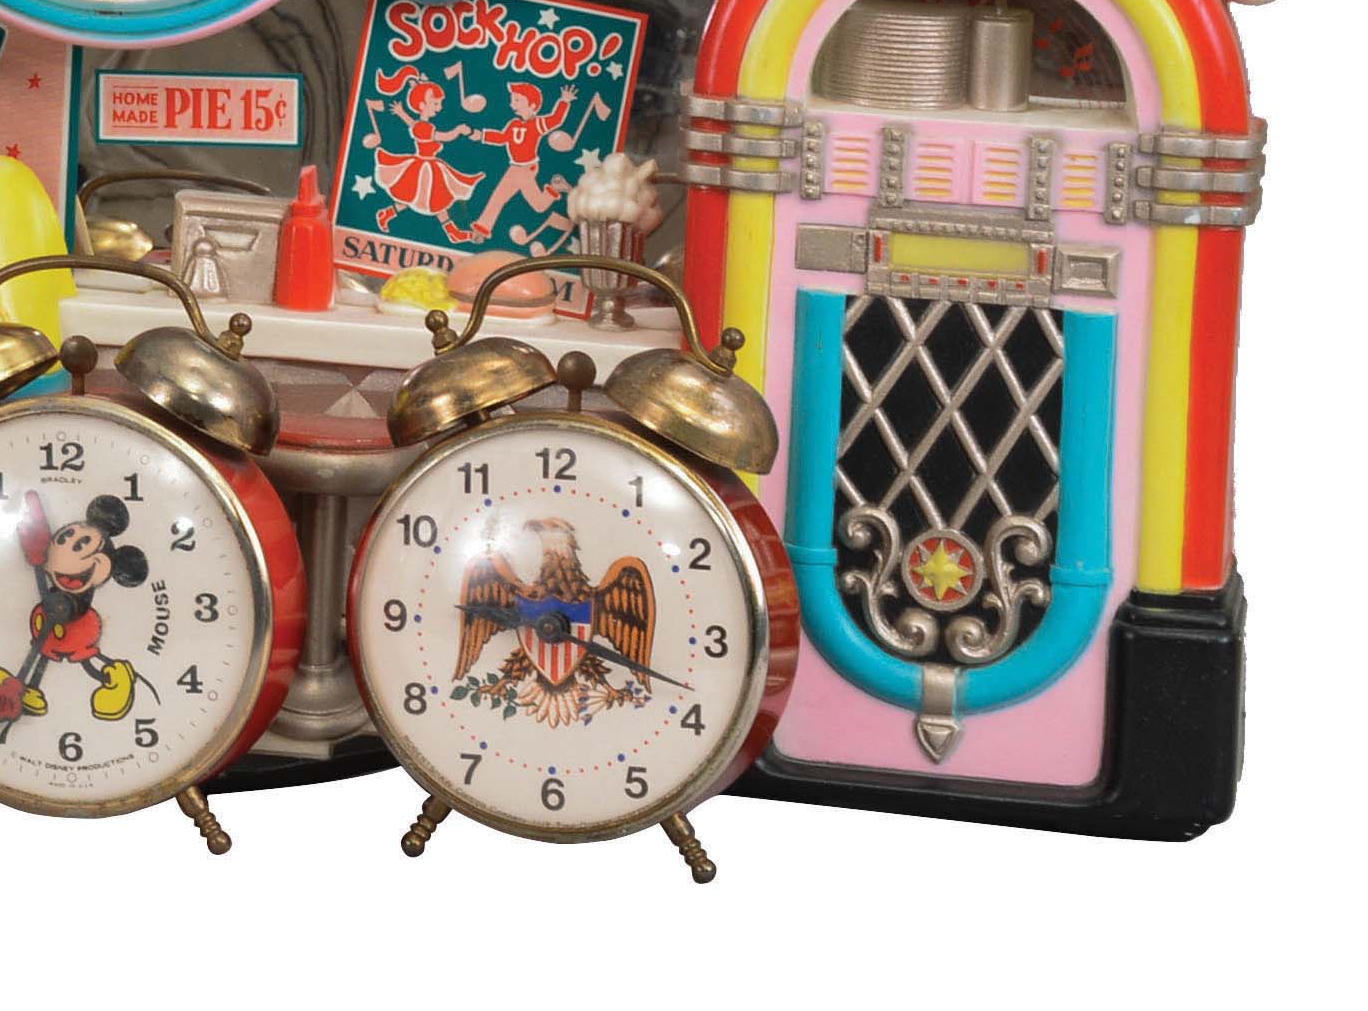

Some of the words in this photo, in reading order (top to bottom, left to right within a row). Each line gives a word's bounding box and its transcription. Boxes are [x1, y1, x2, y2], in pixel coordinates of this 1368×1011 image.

[495, 23, 623, 79] HOP!
[112, 92, 159, 106] HOME
[164, 87, 232, 130] PIE
[240, 88, 287, 131] 15¢
[112, 109, 158, 123] MADE
[512, 127, 527, 145] U
[39, 442, 85, 471] 12
[535, 448, 577, 480] 12
[124, 473, 143, 501] 1
[458, 462, 489, 494] 11
[628, 477, 643, 507] 1
[170, 523, 196, 551] 2
[397, 514, 437, 547] 10
[688, 539, 711, 570] 2
[148, 580, 170, 655] MOUSE
[194, 593, 218, 622] 3
[383, 600, 407, 631] 9
[704, 625, 728, 658] 3
[177, 665, 203, 694] 4
[404, 683, 427, 715] 8
[135, 719, 159, 748] 5
[681, 705, 705, 735] 4
[58, 732, 83, 762] 6
[460, 753, 482, 785] 7
[624, 766, 648, 798] 5
[541, 778, 565, 810] 6
